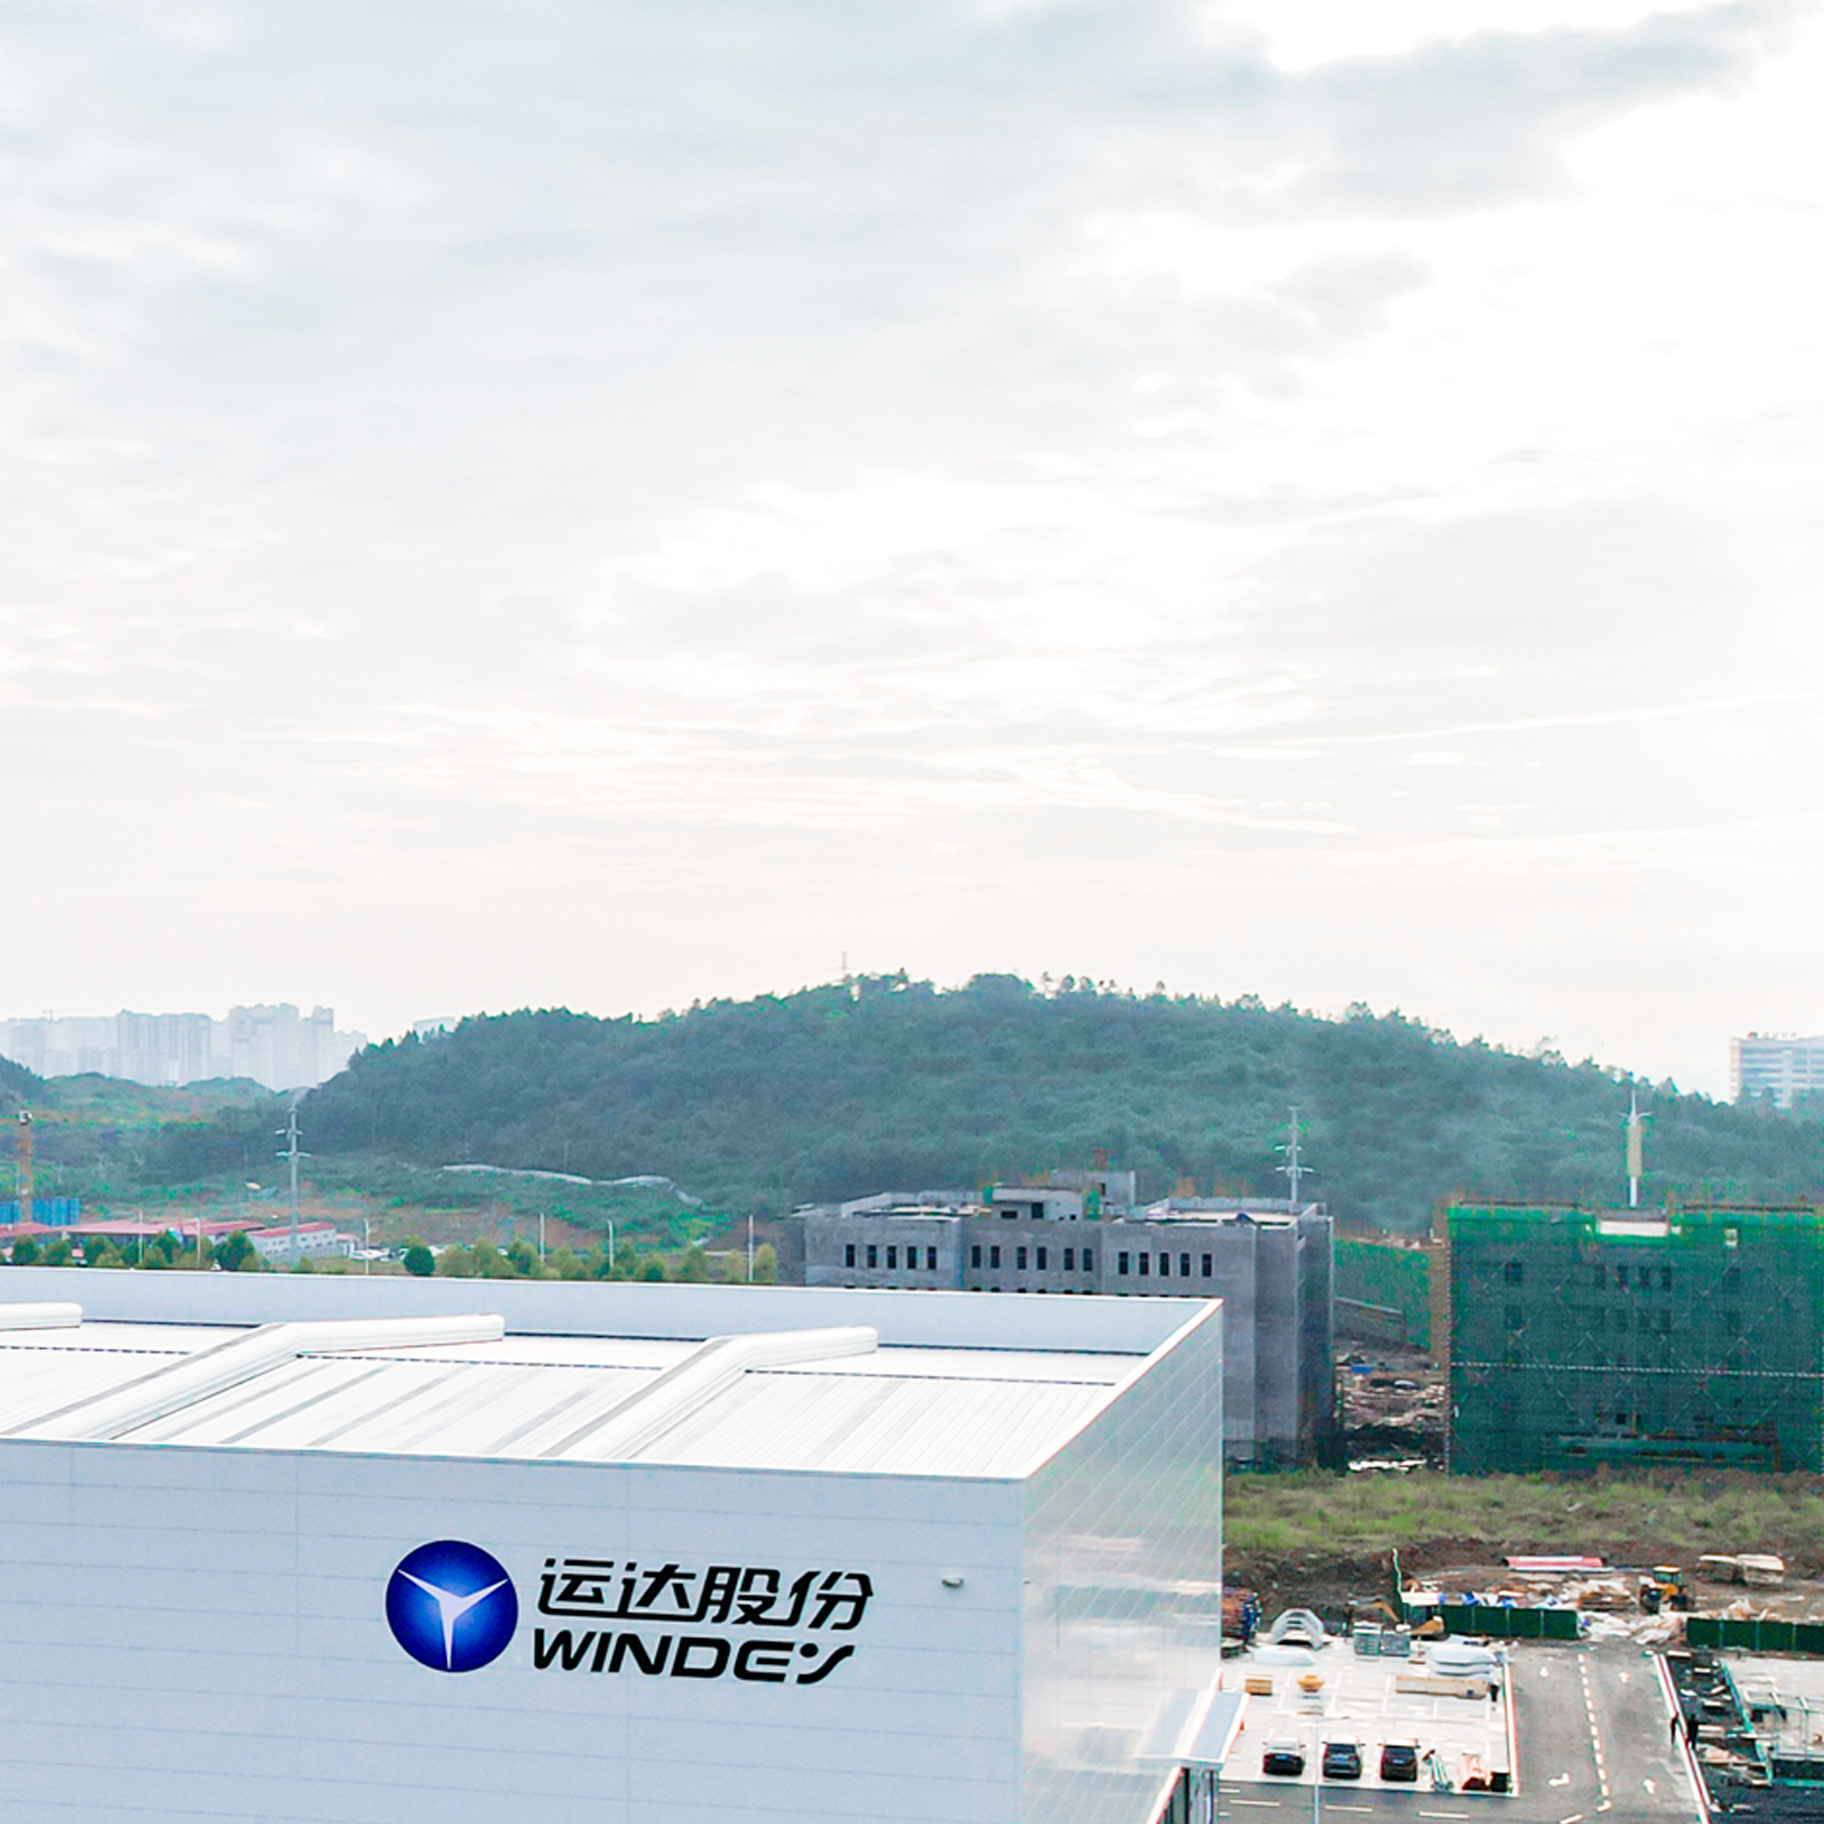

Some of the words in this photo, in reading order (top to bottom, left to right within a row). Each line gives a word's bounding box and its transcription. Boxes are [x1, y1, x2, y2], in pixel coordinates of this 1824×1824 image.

[537, 1557, 874, 1633] 运达股份
[532, 1629, 856, 1685] WINDEY
